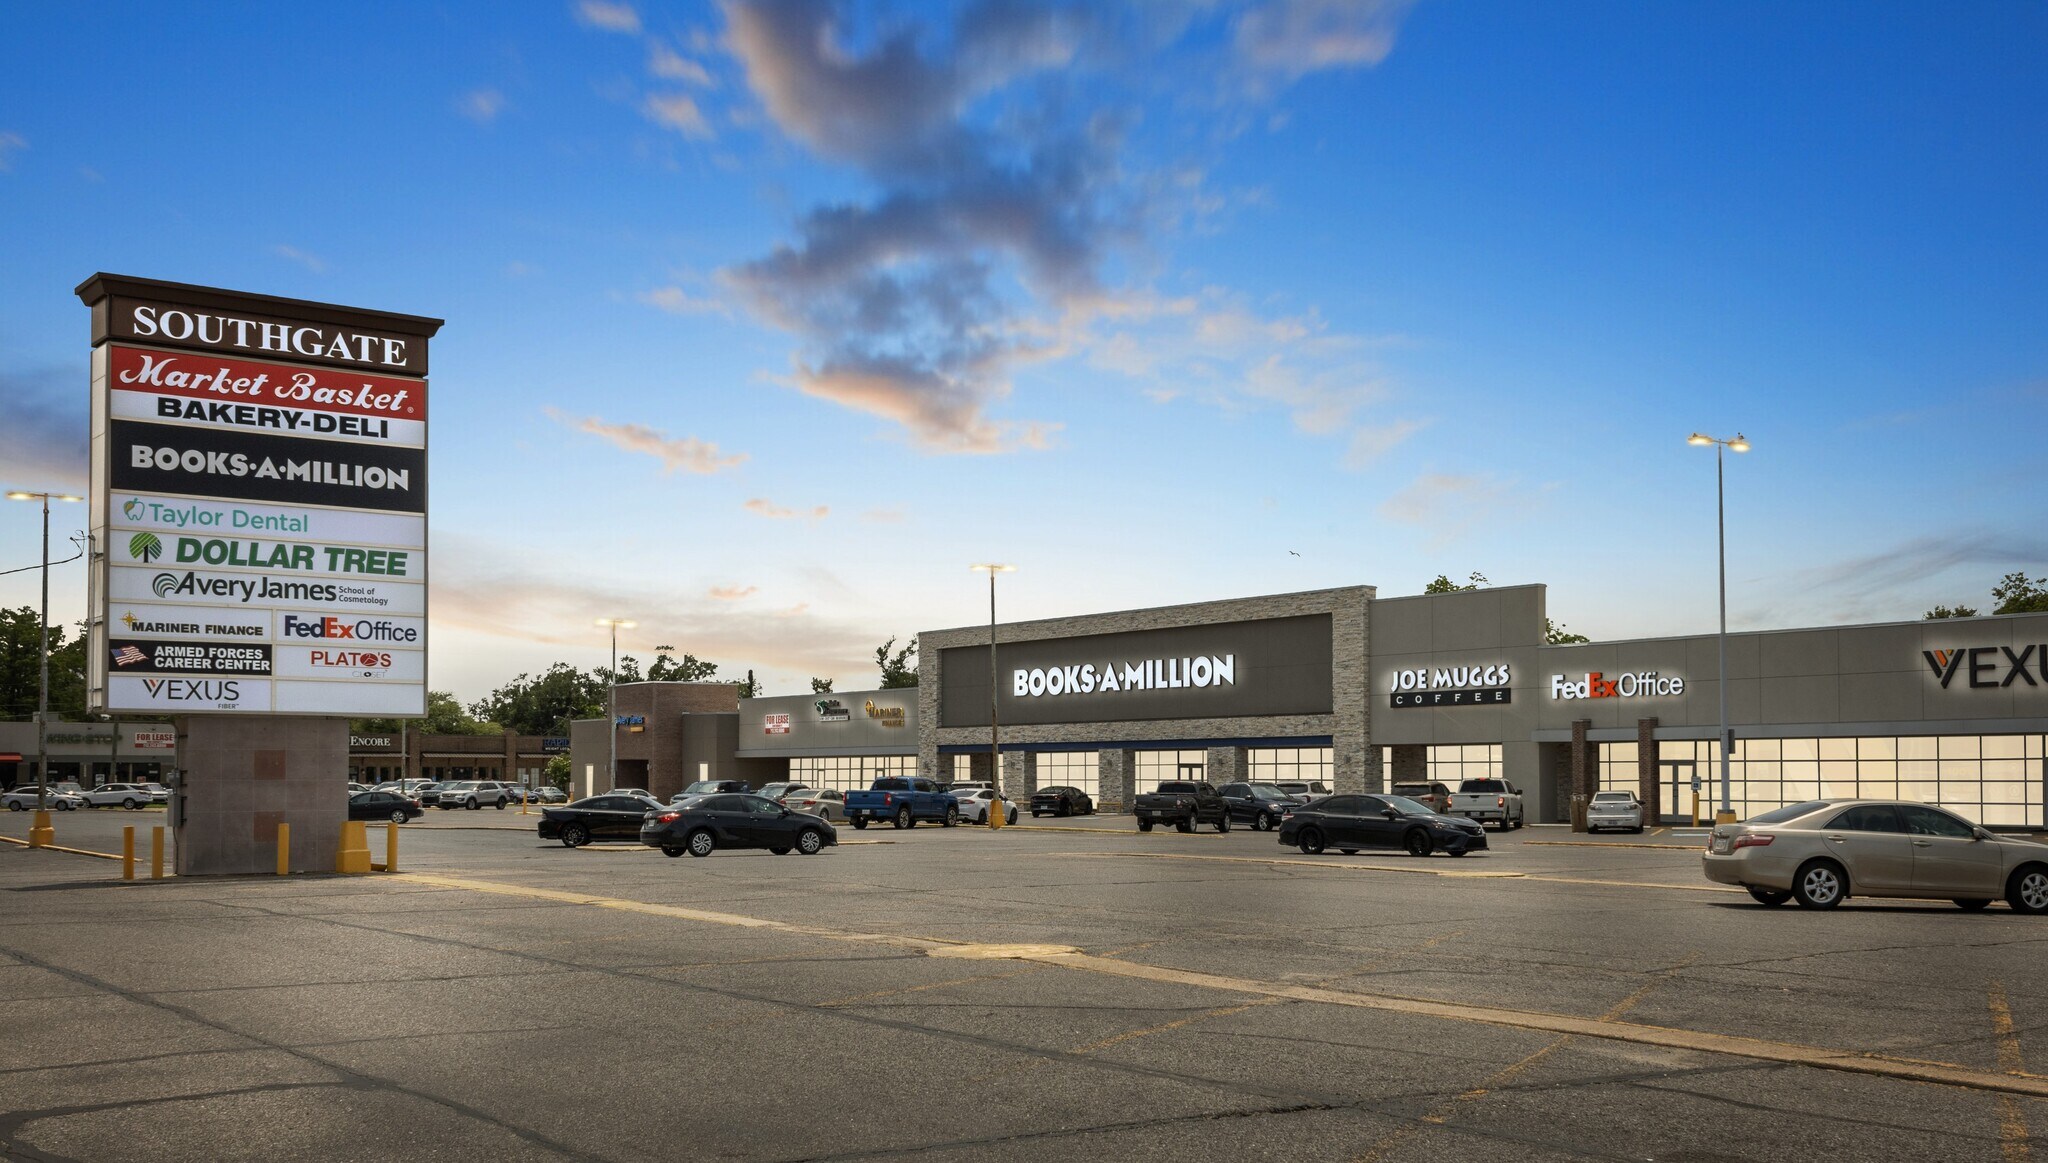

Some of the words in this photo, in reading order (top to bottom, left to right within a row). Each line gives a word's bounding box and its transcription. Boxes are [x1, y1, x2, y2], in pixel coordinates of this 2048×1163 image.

[133, 306, 408, 367] SOUTHGATE
[120, 355, 269, 396] Market
[275, 372, 409, 411] Basket
[157, 396, 389, 439] BAKERY-DELI
[149, 503, 224, 527] Taylor
[232, 509, 309, 533] Dental
[176, 537, 315, 571] DOLLAR
[324, 547, 409, 576] TREE
[338, 585, 365, 595] School
[366, 587, 375, 595] of
[338, 594, 389, 606] Cosmetology
[132, 621, 200, 635] MARINER
[205, 624, 264, 636] FINANCE
[154, 645, 205, 659] ARMED
[209, 647, 264, 661] FORCES
[311, 650, 392, 668] PLATO'S
[154, 656, 211, 670] CAREER
[215, 658, 271, 672] CENTER
[352, 670, 386, 679] CLOSET
[1391, 668, 1429, 692] JOE
[1432, 664, 1511, 689] MUGGS
[142, 679, 240, 701] VEXUS
[1395, 691, 1503, 705] COFFEE
[766, 715, 775, 724] FOR
[775, 714, 789, 724] LEASE
[136, 733, 151, 741] FOR
[152, 733, 174, 741] LEASE
